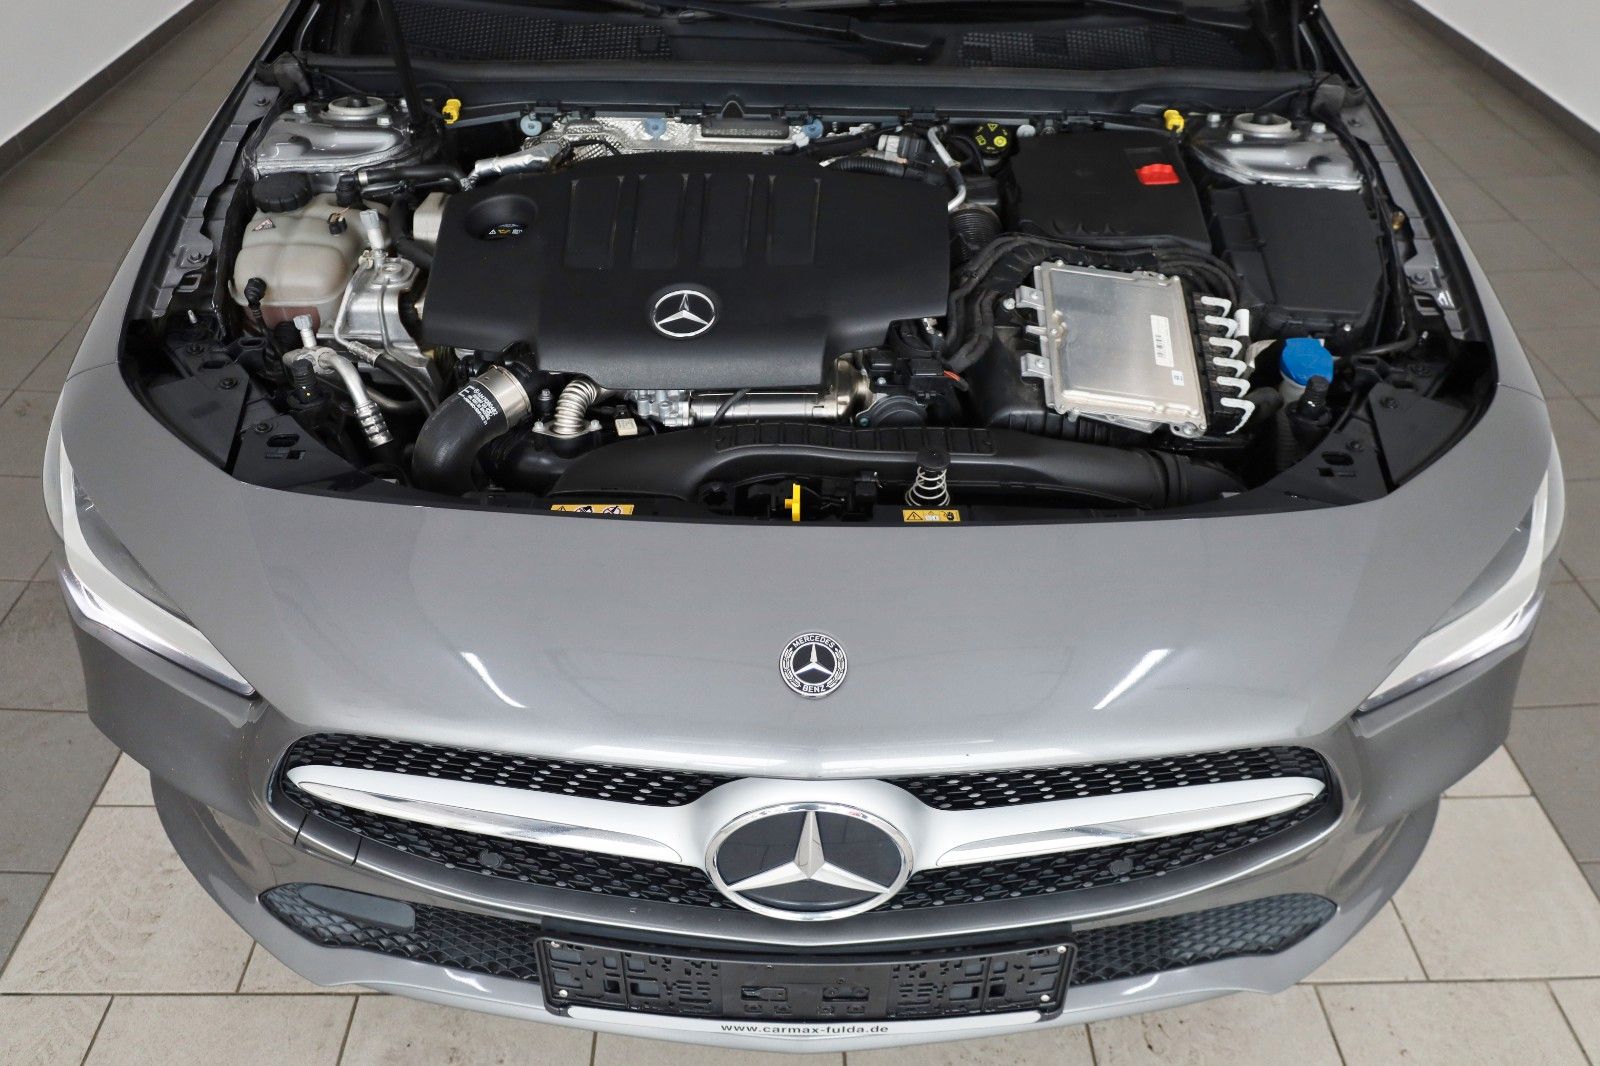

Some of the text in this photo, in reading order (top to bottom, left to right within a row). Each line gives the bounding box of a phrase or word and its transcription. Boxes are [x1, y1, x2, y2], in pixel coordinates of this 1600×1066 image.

[793, 635, 835, 648] MERCEDES
[802, 684, 826, 693] BENZ
[720, 1023, 889, 1034] www.carmax-fulda.de
